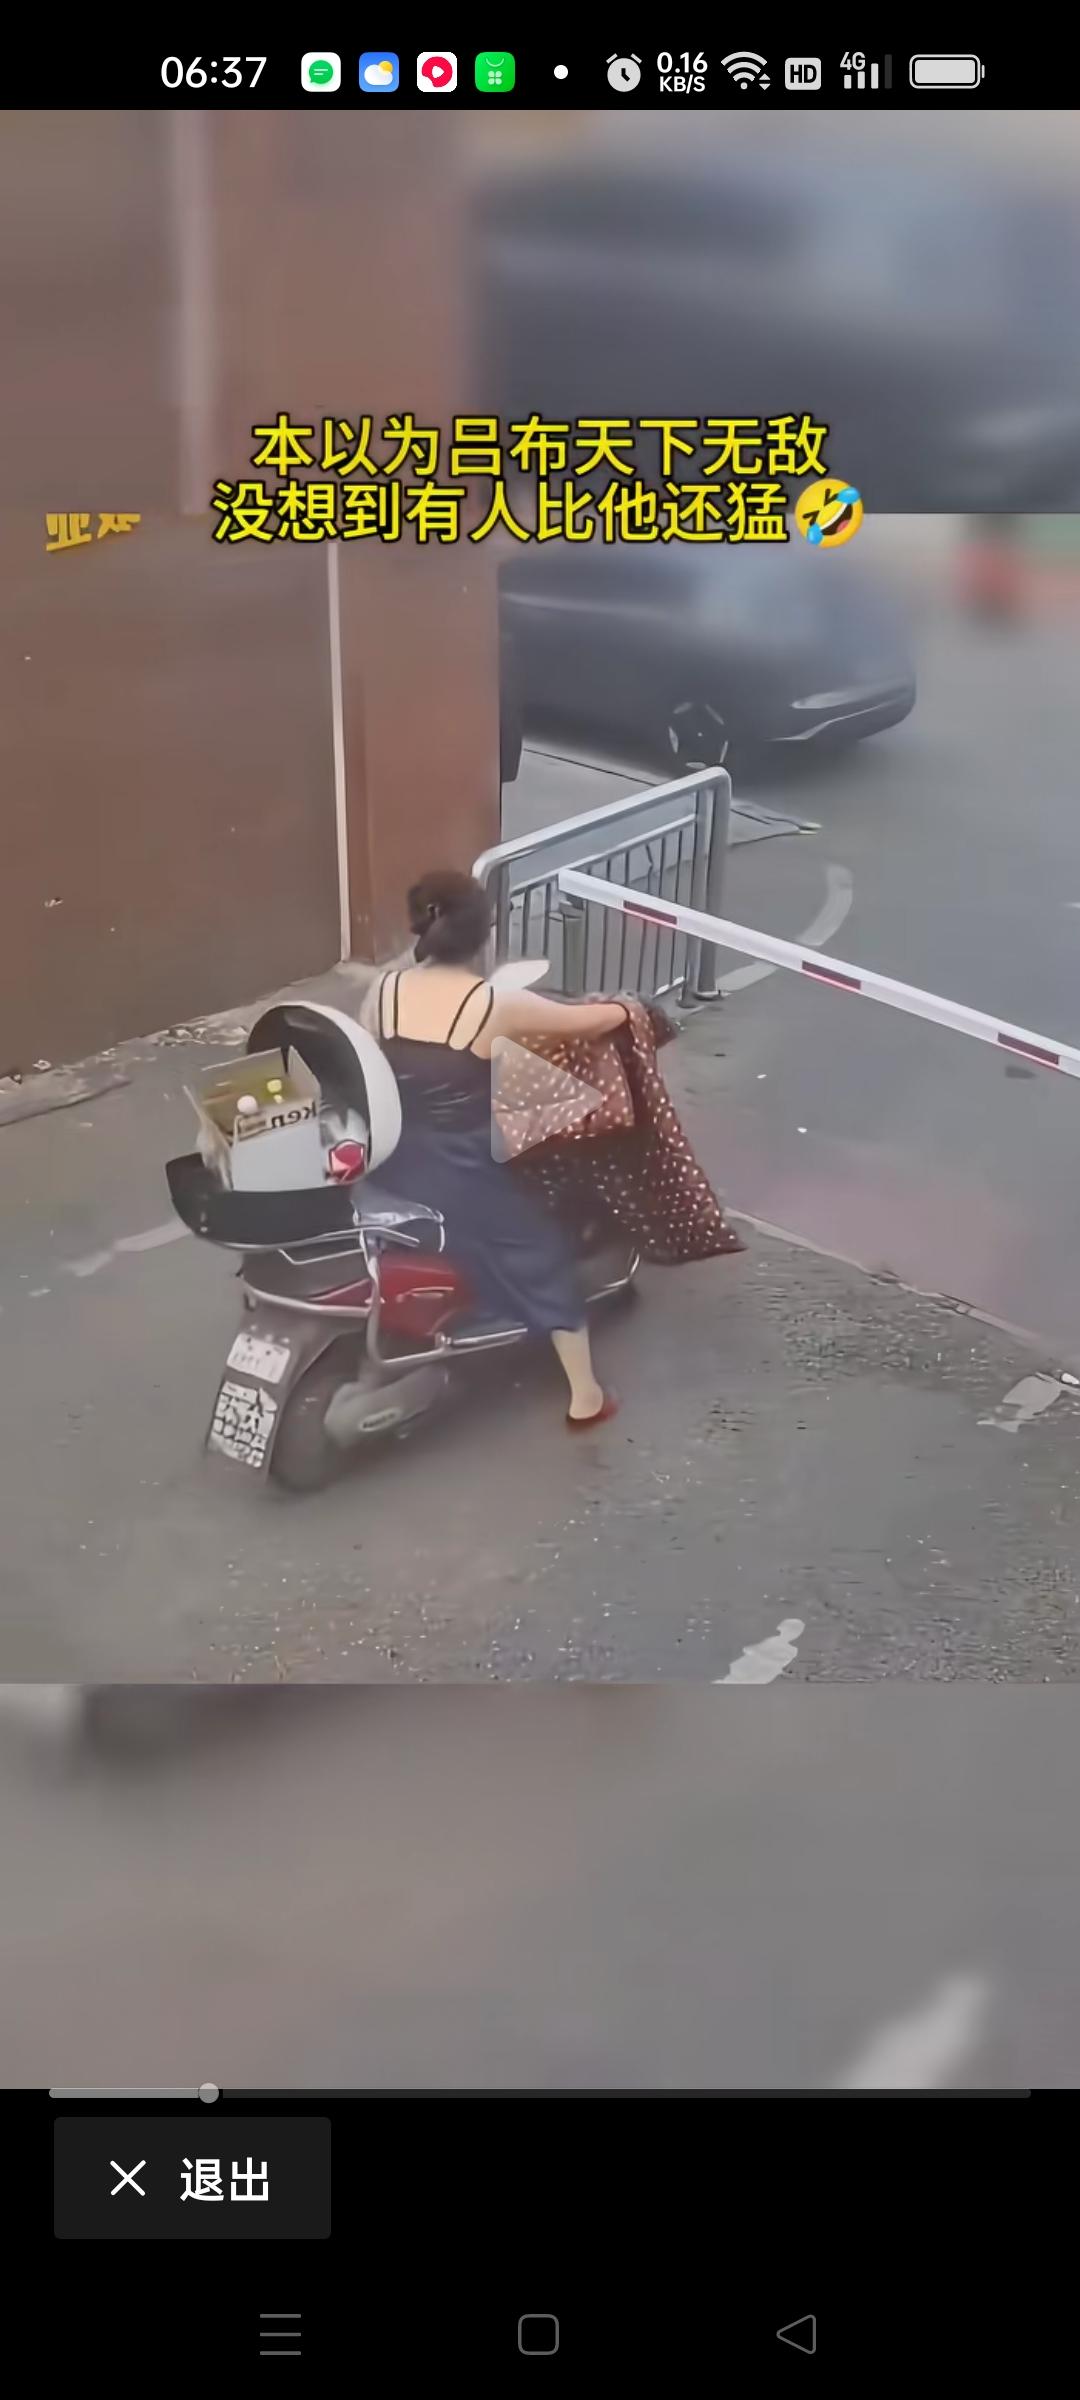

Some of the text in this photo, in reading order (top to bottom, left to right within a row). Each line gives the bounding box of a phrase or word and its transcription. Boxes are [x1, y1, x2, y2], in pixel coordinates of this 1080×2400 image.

[656, 51, 708, 74] 0.16
[839, 51, 866, 71] 4G
[160, 56, 267, 89] 06:37
[789, 64, 817, 84] HD
[659, 74, 706, 94] KB/S
[179, 2156, 270, 2202] 退出
